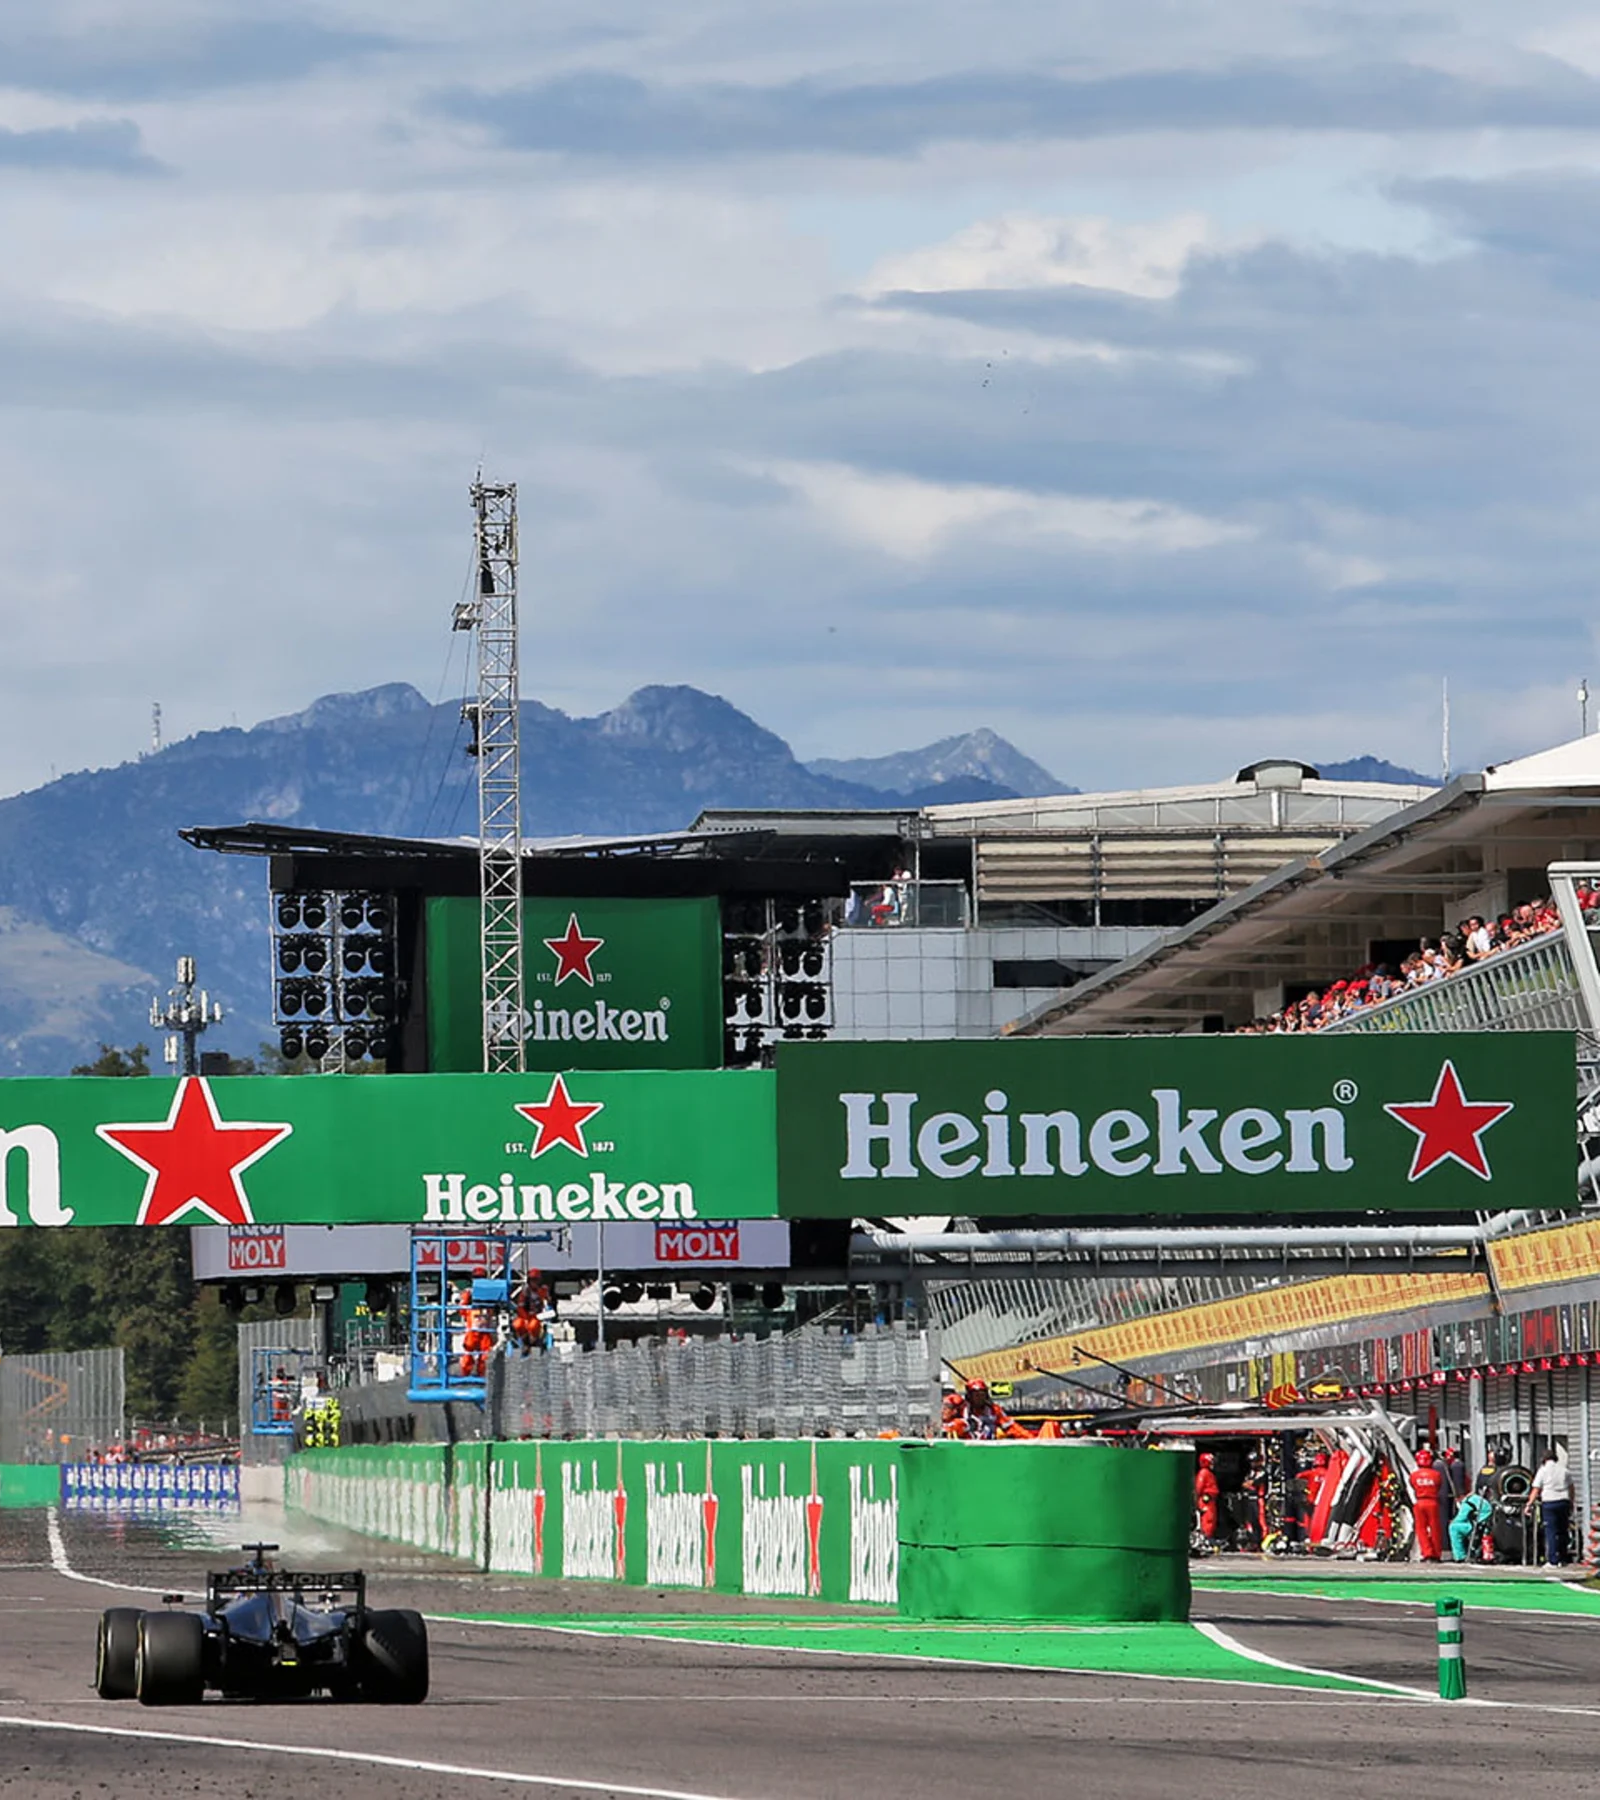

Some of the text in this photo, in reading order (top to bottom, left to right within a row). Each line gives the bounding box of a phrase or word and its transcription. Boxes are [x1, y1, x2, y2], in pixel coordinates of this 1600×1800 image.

[505, 1142, 527, 1154] EST.
[422, 1173, 698, 1221] Heineken
[231, 1239, 283, 1267] MOLY
[660, 1231, 737, 1258] MOLY
